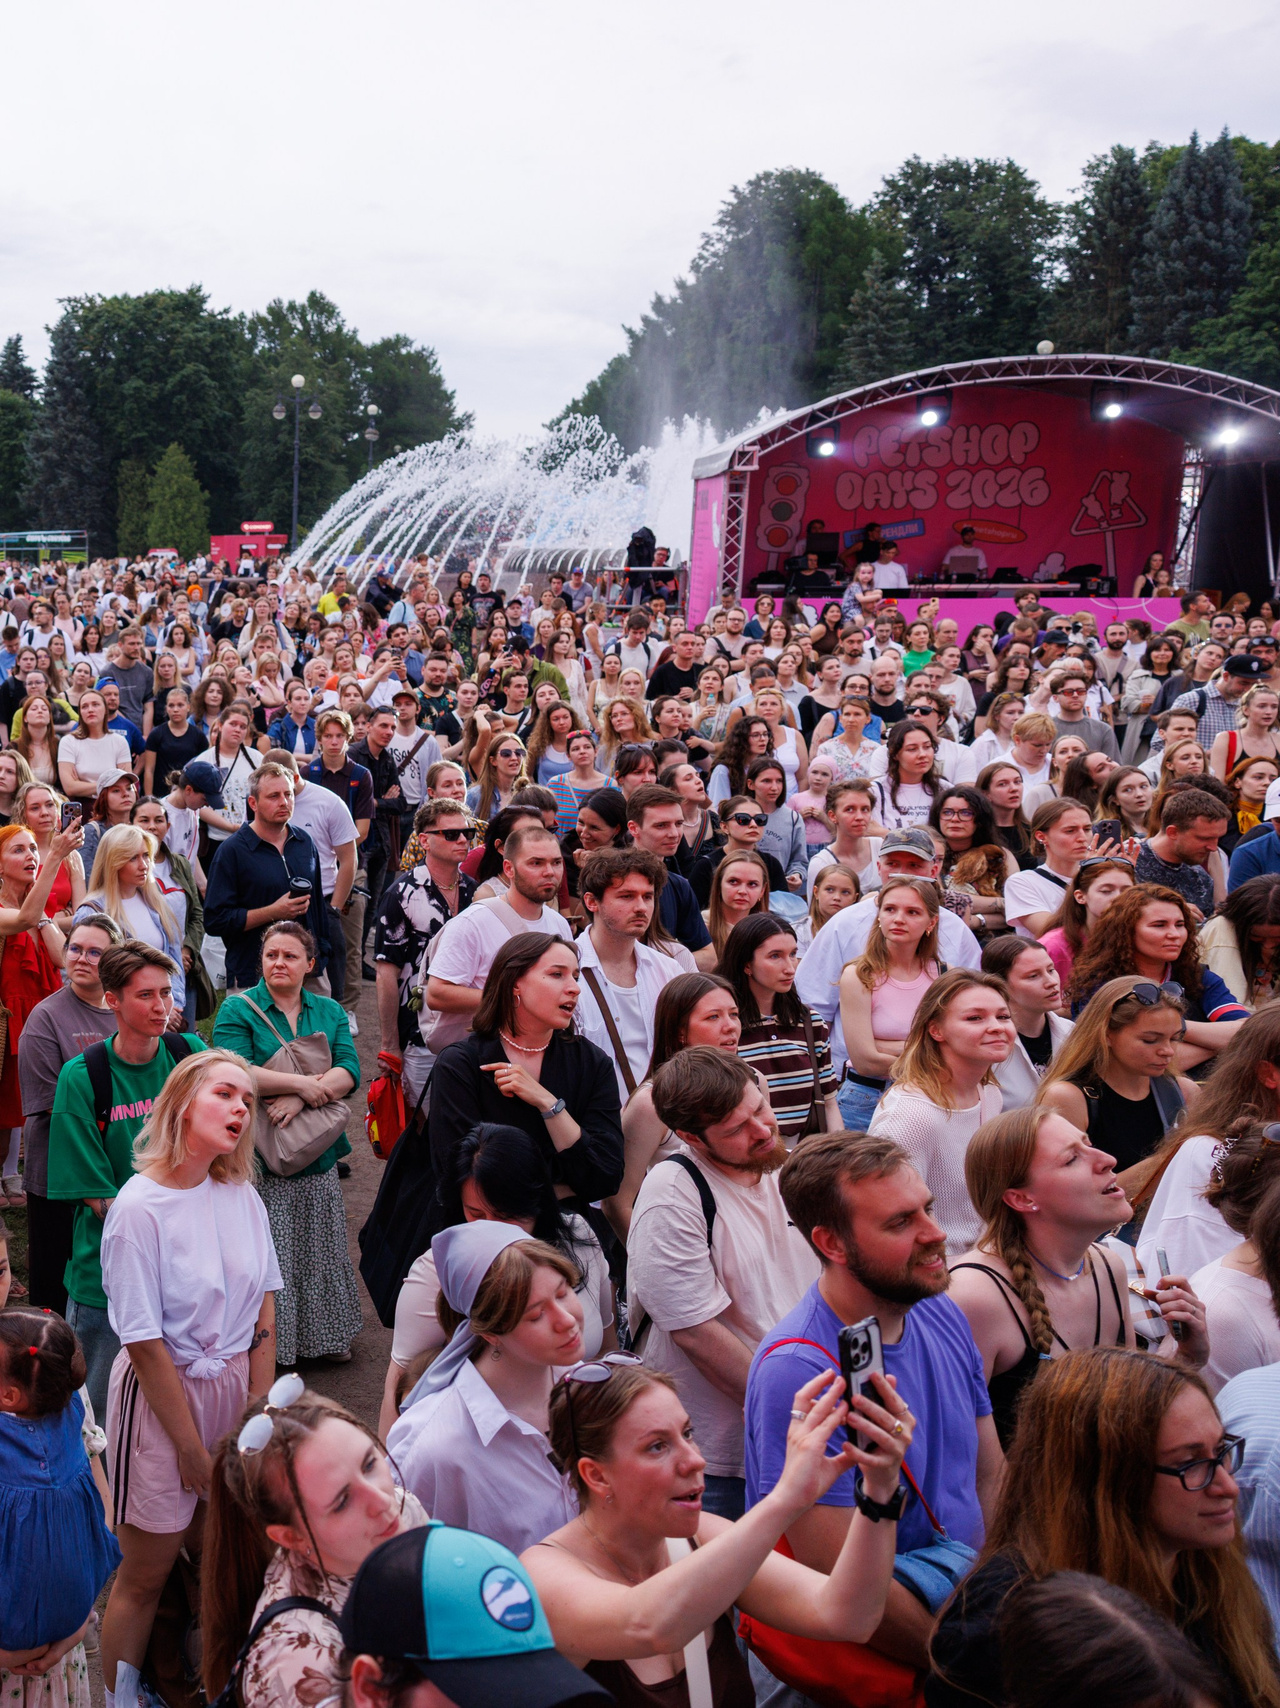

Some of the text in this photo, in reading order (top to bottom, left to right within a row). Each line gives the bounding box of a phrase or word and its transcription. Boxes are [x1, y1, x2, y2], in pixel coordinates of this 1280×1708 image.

[852, 420, 1041, 468] PETSHOP
[835, 466, 1051, 511] DAYS 2026
[765, 829, 783, 842] sport
[110, 1096, 160, 1122] MNIM
